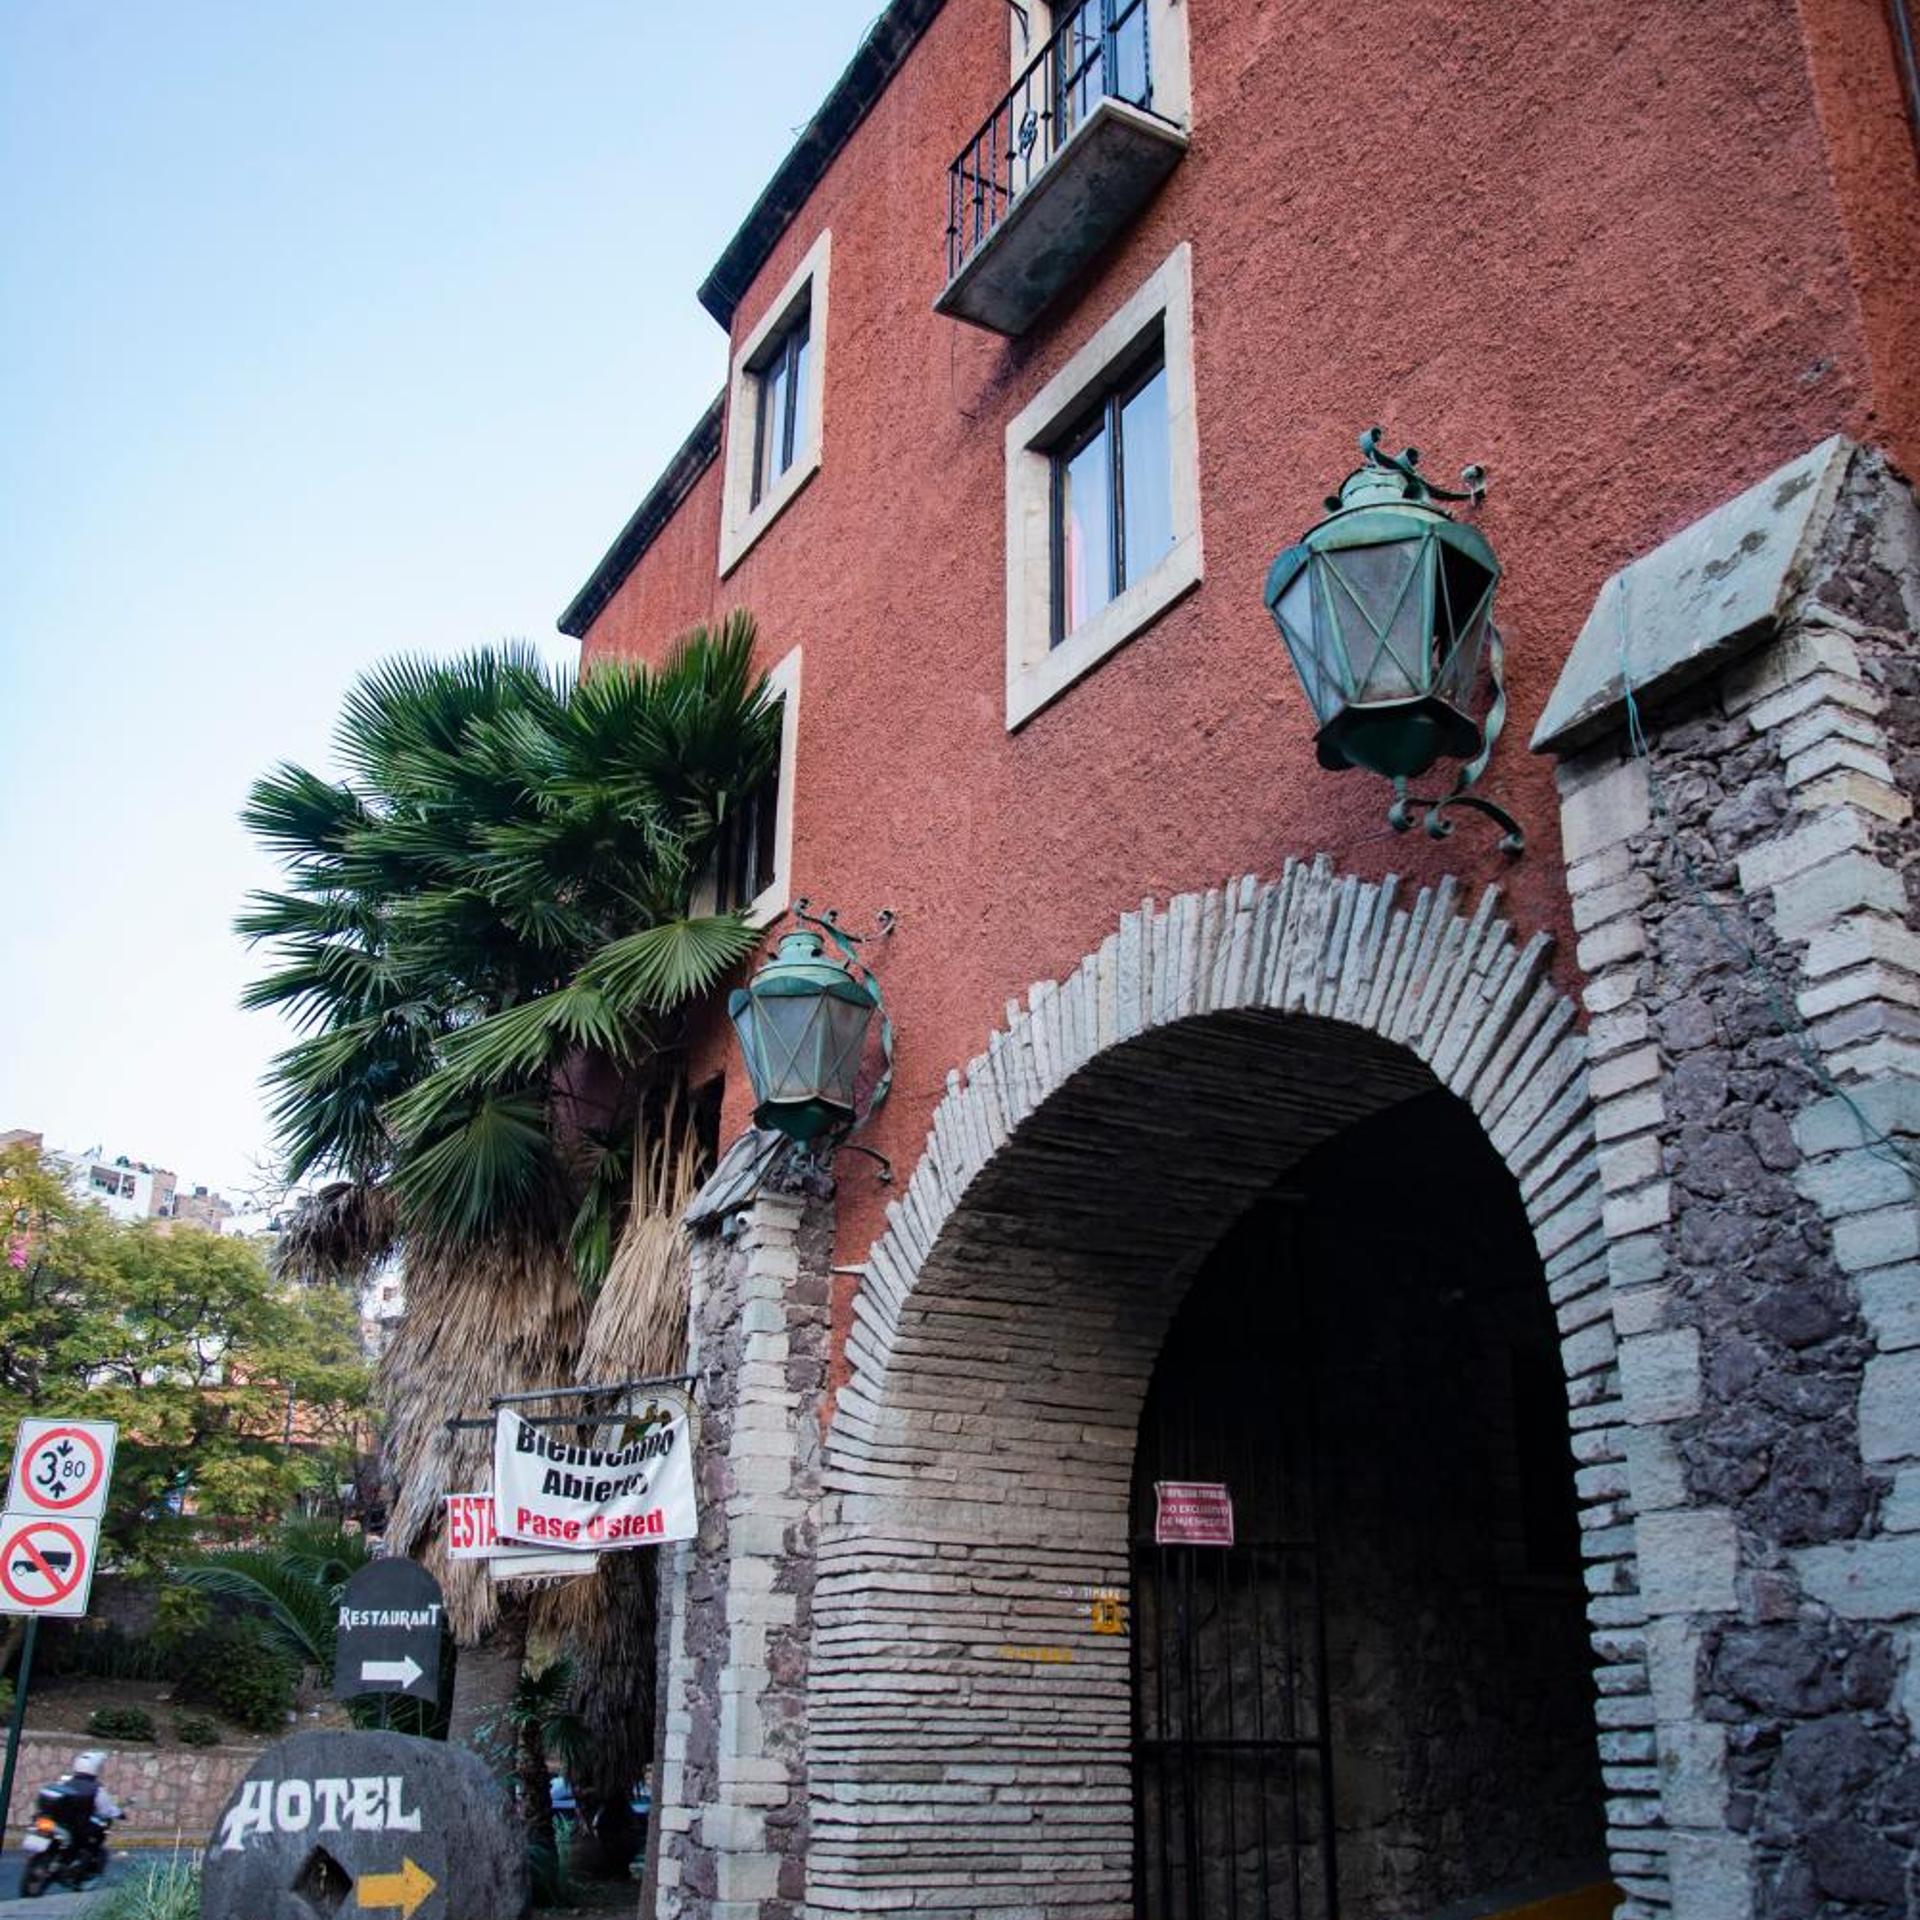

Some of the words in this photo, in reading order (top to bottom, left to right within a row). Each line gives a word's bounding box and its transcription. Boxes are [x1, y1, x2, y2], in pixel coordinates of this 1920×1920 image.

[542, 1468, 648, 1503] Abierto
[450, 1497, 506, 1548] ESTA
[517, 1506, 581, 1541] Pase
[586, 1507, 665, 1540] Usted
[220, 1776, 421, 1851] HOTEL
